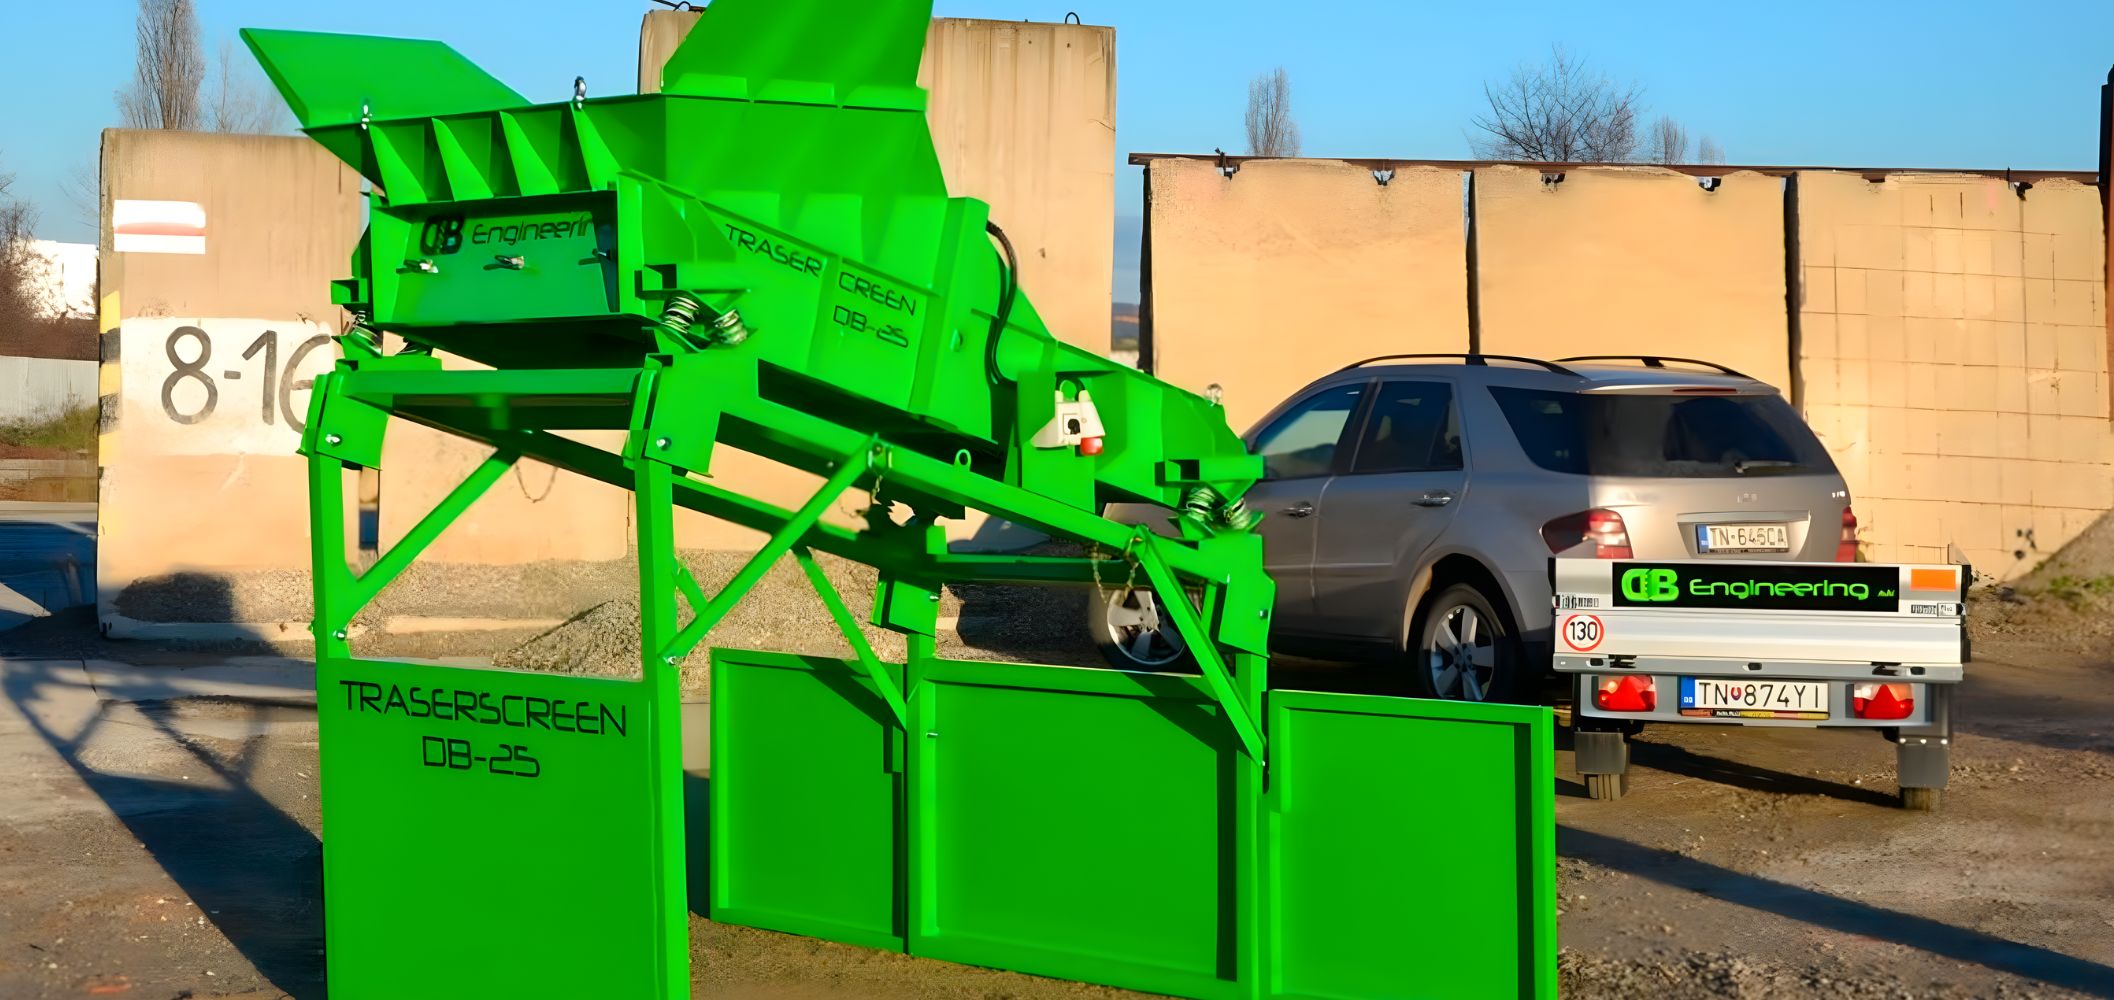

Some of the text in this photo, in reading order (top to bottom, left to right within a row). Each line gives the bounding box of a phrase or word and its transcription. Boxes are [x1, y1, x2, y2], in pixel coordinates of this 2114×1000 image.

[472, 215, 594, 246] Engineerin
[726, 223, 822, 277] TRASER
[833, 305, 908, 348] DB-25
[1689, 579, 1869, 600] Engineering
[1569, 621, 1598, 641] 130
[339, 680, 626, 737] TRASERSCREEN
[422, 736, 540, 778] DB-25
